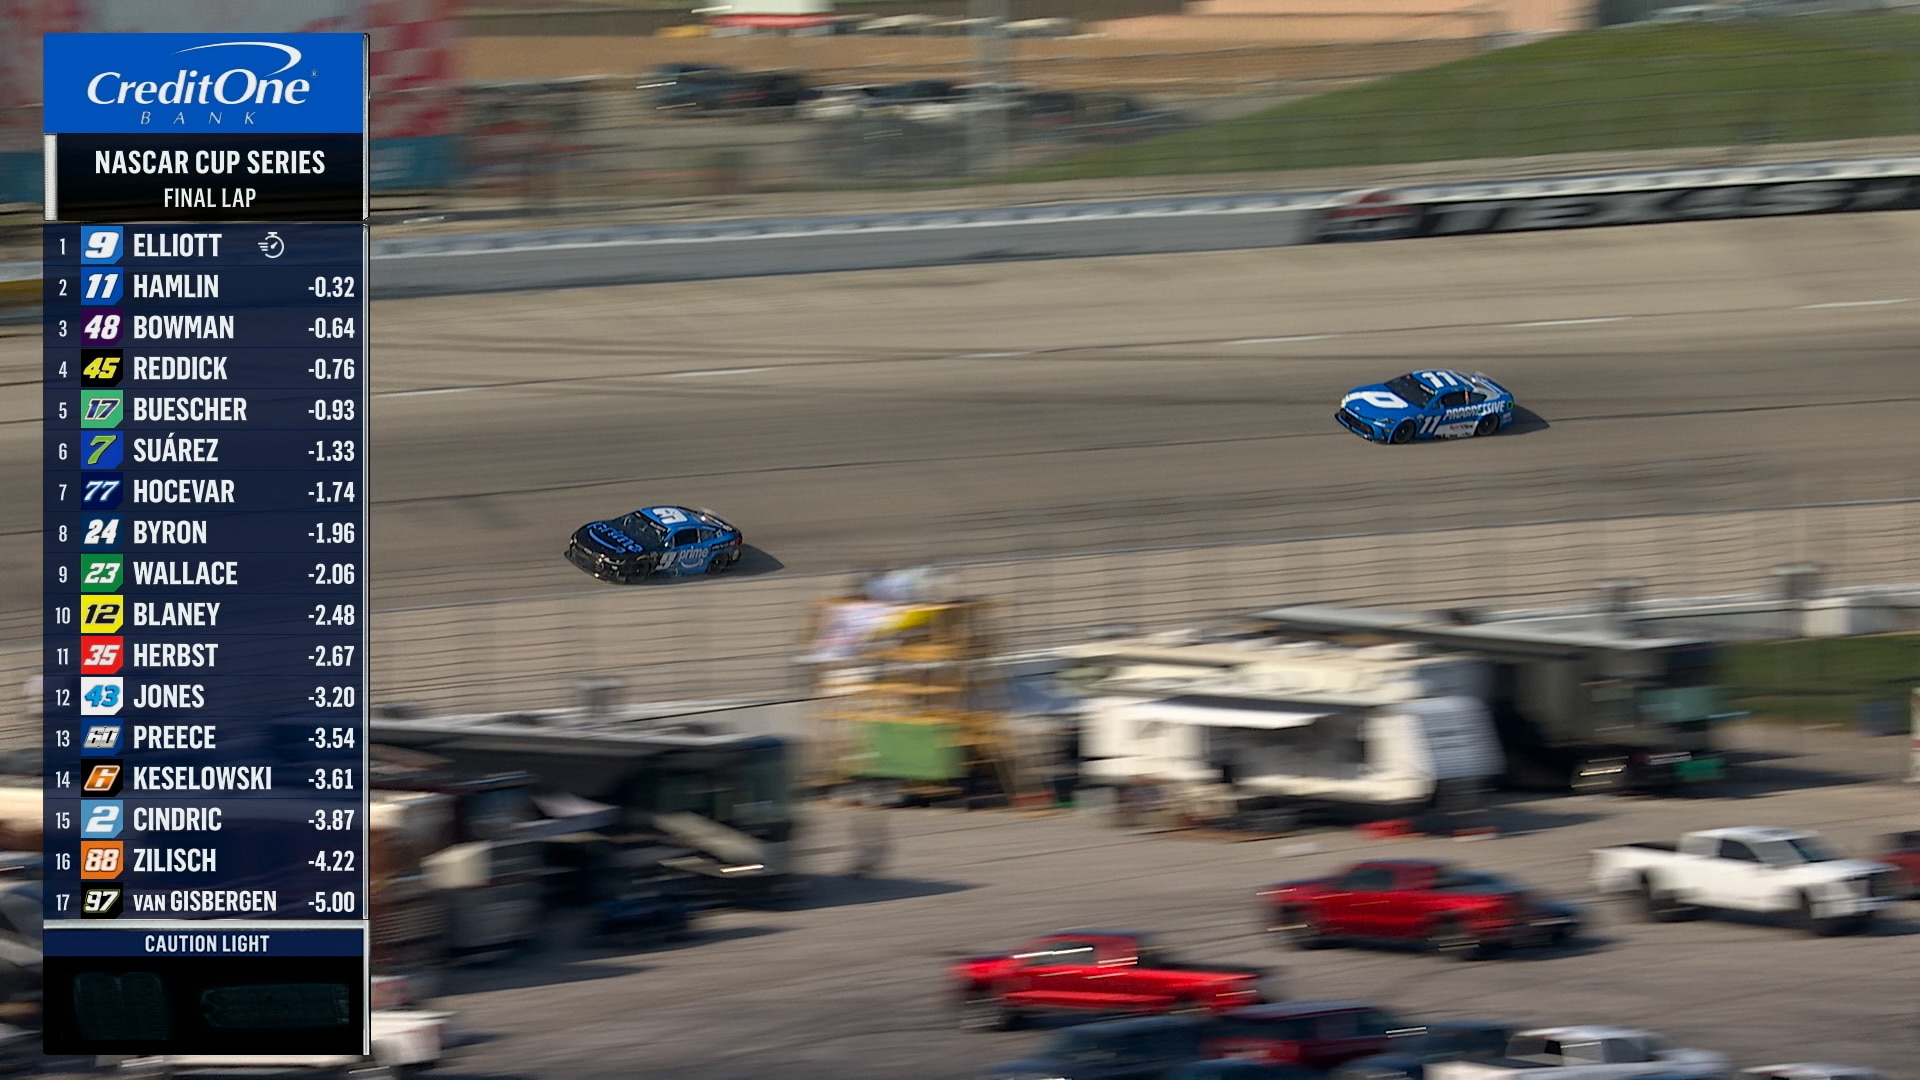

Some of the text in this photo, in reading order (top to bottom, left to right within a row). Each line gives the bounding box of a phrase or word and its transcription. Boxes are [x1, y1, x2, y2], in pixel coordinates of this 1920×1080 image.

[1421, 371, 1458, 389] 11
[1419, 415, 1441, 434] 11
[656, 551, 677, 570] 9
[678, 546, 709, 562] prime
